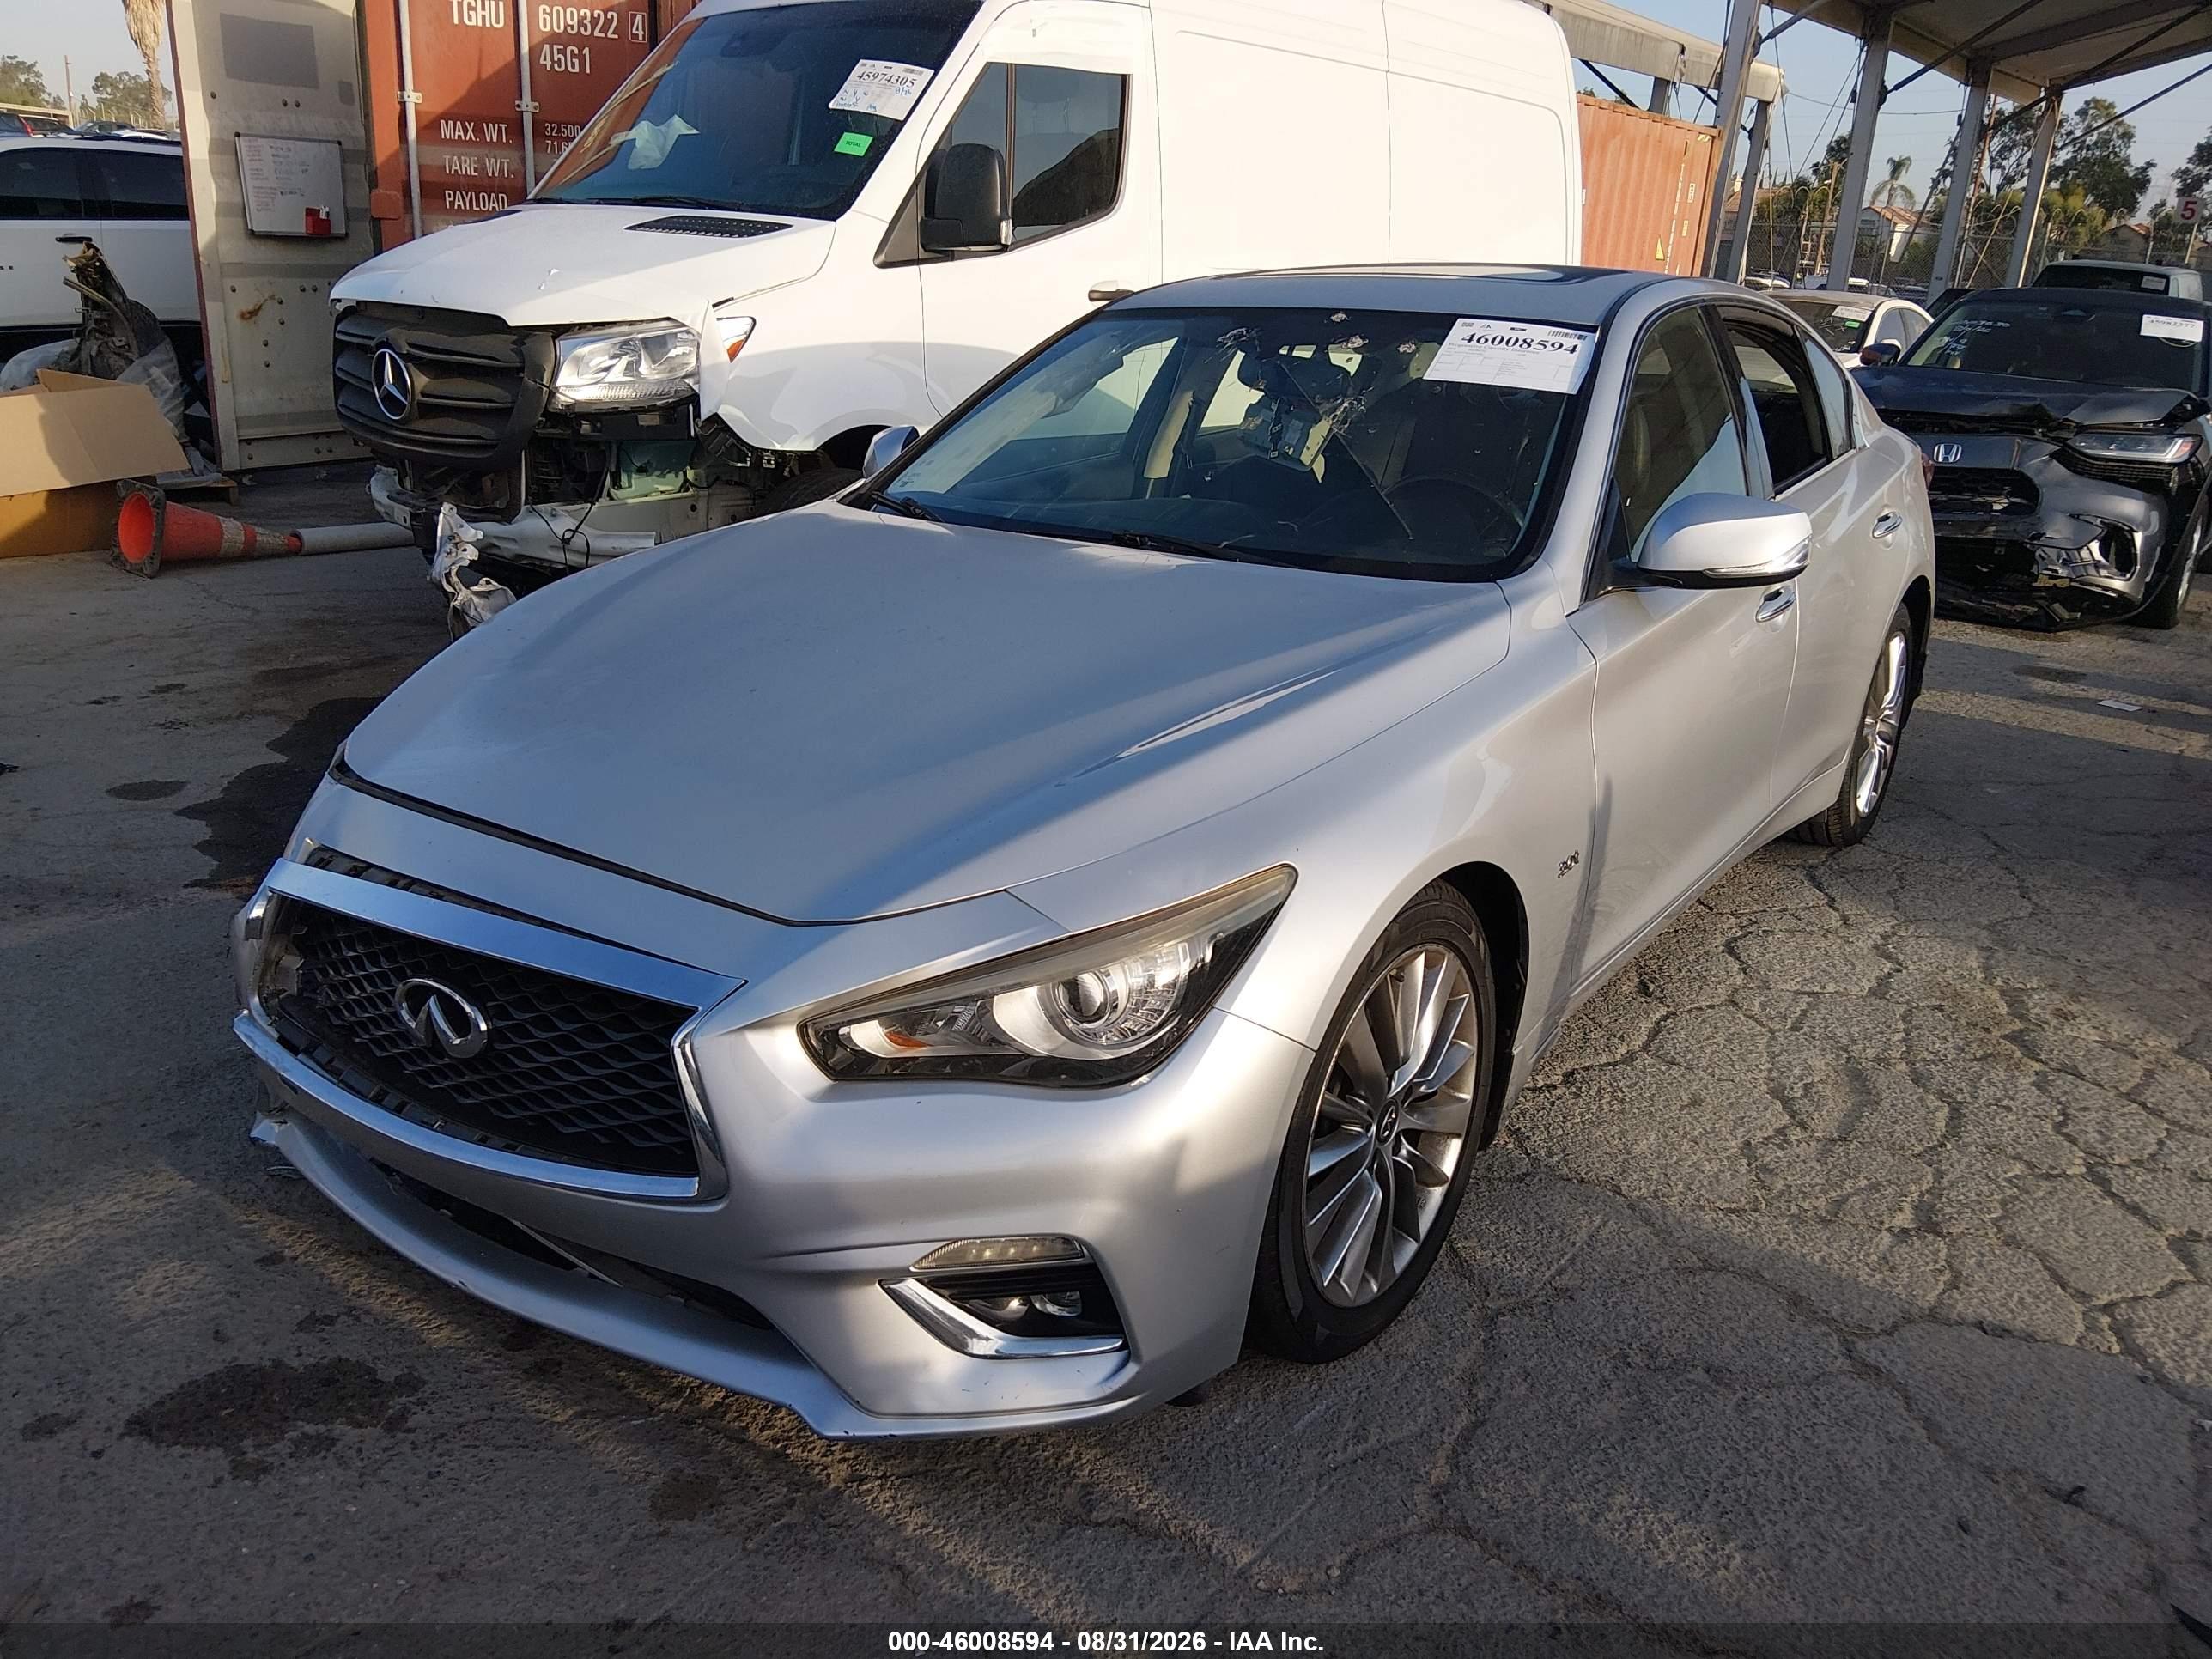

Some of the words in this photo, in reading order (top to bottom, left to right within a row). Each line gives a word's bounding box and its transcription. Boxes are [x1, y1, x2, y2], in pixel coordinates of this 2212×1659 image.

[449, 0, 505, 28] TGHU
[538, 4, 618, 39] 609322
[631, 14, 644, 40] 4
[539, 44, 592, 74] 45G1
[857, 70, 916, 88] 45974305
[440, 119, 480, 142] MAX.
[483, 122, 513, 144] WT.
[443, 155, 478, 176] TARE
[485, 158, 514, 179] WT.
[445, 190, 508, 211] PAYLOAD
[2181, 201, 2197, 220] 5
[1461, 331, 1579, 355] 46008594
